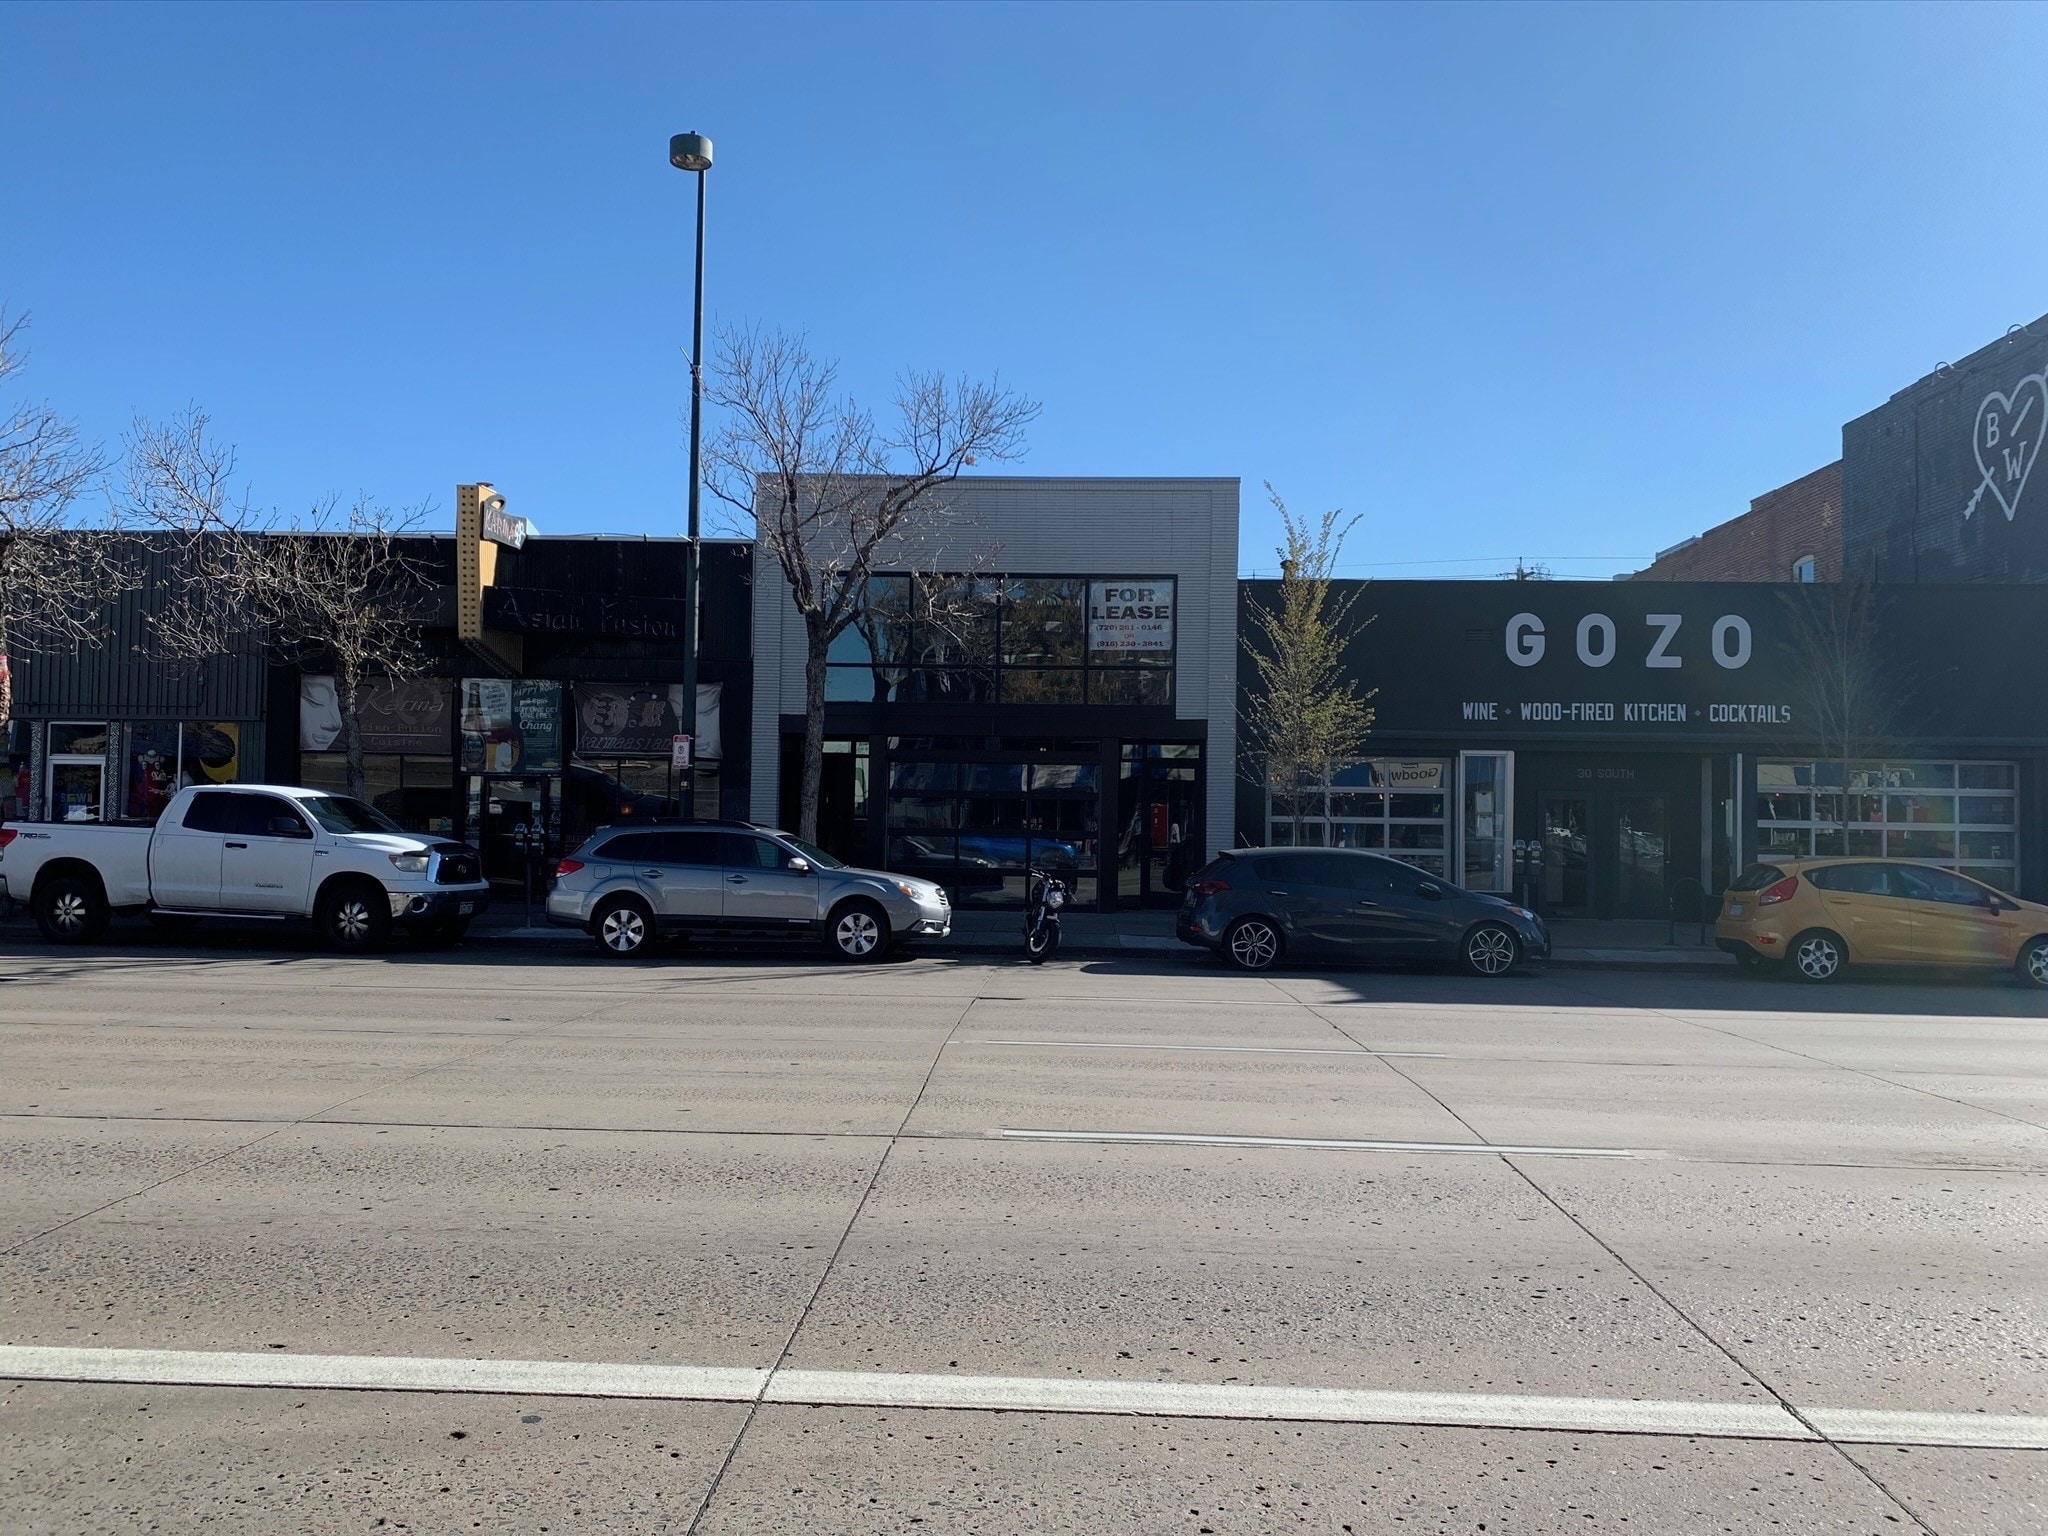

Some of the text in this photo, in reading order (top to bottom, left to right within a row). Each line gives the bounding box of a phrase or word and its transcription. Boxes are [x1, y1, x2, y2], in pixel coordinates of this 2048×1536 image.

[1105, 588, 1155, 602] FOR
[1091, 605, 1170, 620] LEASE
[1505, 612, 1752, 670] GOZO
[356, 684, 445, 716] Karma
[1462, 702, 1791, 724] WINE WOOD-FIRED KITCHEN COCKTAILS
[397, 723, 443, 733] Fusion
[519, 719, 553, 732] Chang
[370, 736, 424, 747] Cuisine
[1577, 768, 1635, 779] 30 SOUTH
